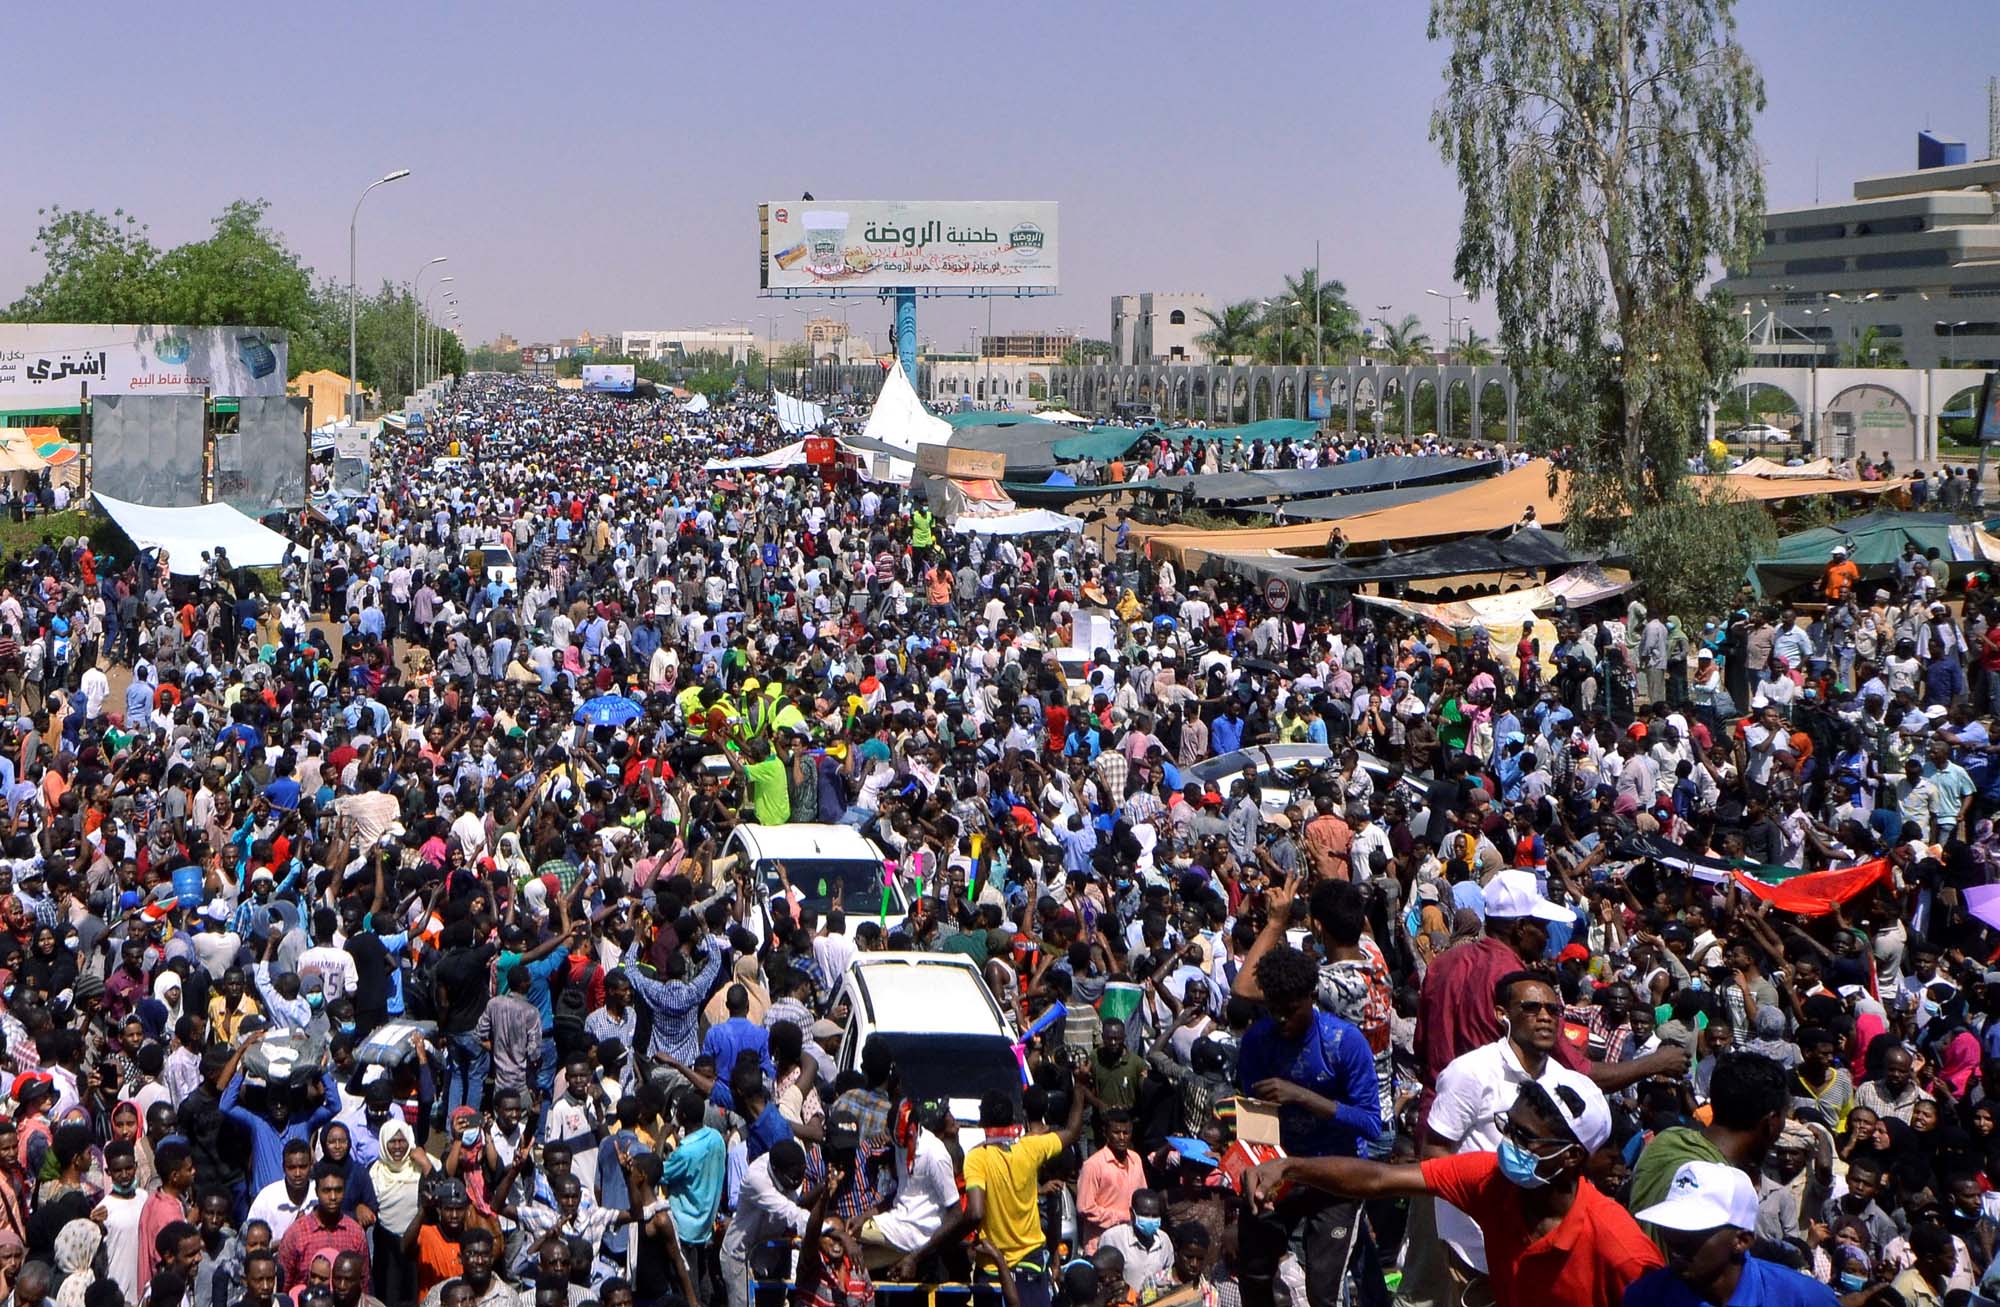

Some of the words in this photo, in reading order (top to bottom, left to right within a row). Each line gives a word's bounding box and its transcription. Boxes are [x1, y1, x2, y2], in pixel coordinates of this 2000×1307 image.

[864, 221, 941, 248] الروضة
[946, 226, 998, 246] طحنية
[884, 261, 912, 272] الروضة
[27, 351, 106, 384] إشتري
[130, 373, 155, 389] البيع
[157, 373, 182, 385] نقاط
[184, 375, 209, 385] خدمة
